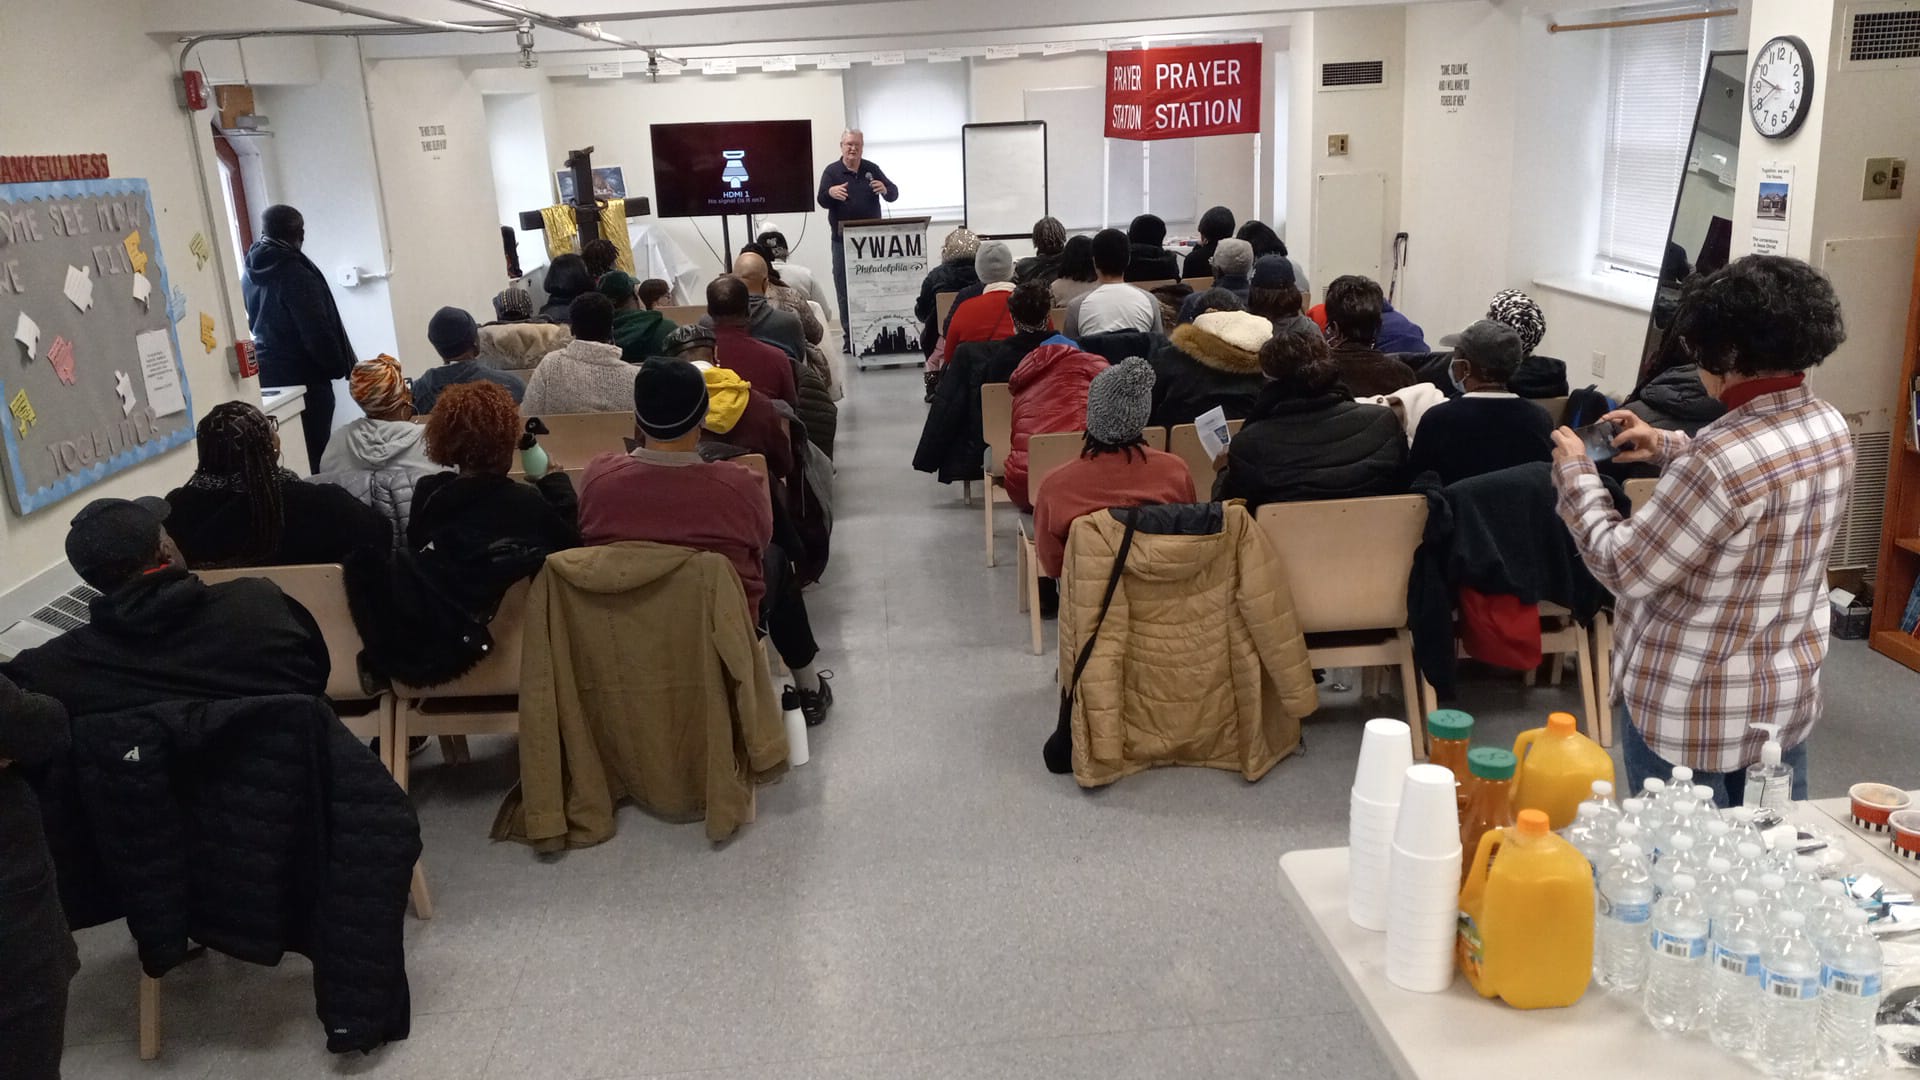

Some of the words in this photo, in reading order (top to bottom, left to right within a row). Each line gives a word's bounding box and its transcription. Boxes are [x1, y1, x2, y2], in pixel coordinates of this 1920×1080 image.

[1769, 51, 1775, 65] 11
[1777, 47, 1786, 61] 12
[1156, 59, 1241, 90] PRAYER
[1760, 63, 1768, 77] 10
[1793, 63, 1800, 77] 2
[1114, 65, 1141, 91] PRAYER
[1755, 80, 1762, 93] 9
[1793, 81, 1800, 94] 3
[1757, 97, 1763, 111] 8
[1789, 98, 1795, 112] 4
[1112, 104, 1142, 130] STATION
[1155, 98, 1241, 129] STATION
[1763, 110, 1769, 123] 7
[1771, 114, 1778, 127] 6
[1781, 110, 1787, 124] 5
[49, 201, 88, 237] SEE
[850, 234, 922, 259] YWAM
[855, 262, 908, 275] Philadelphia
